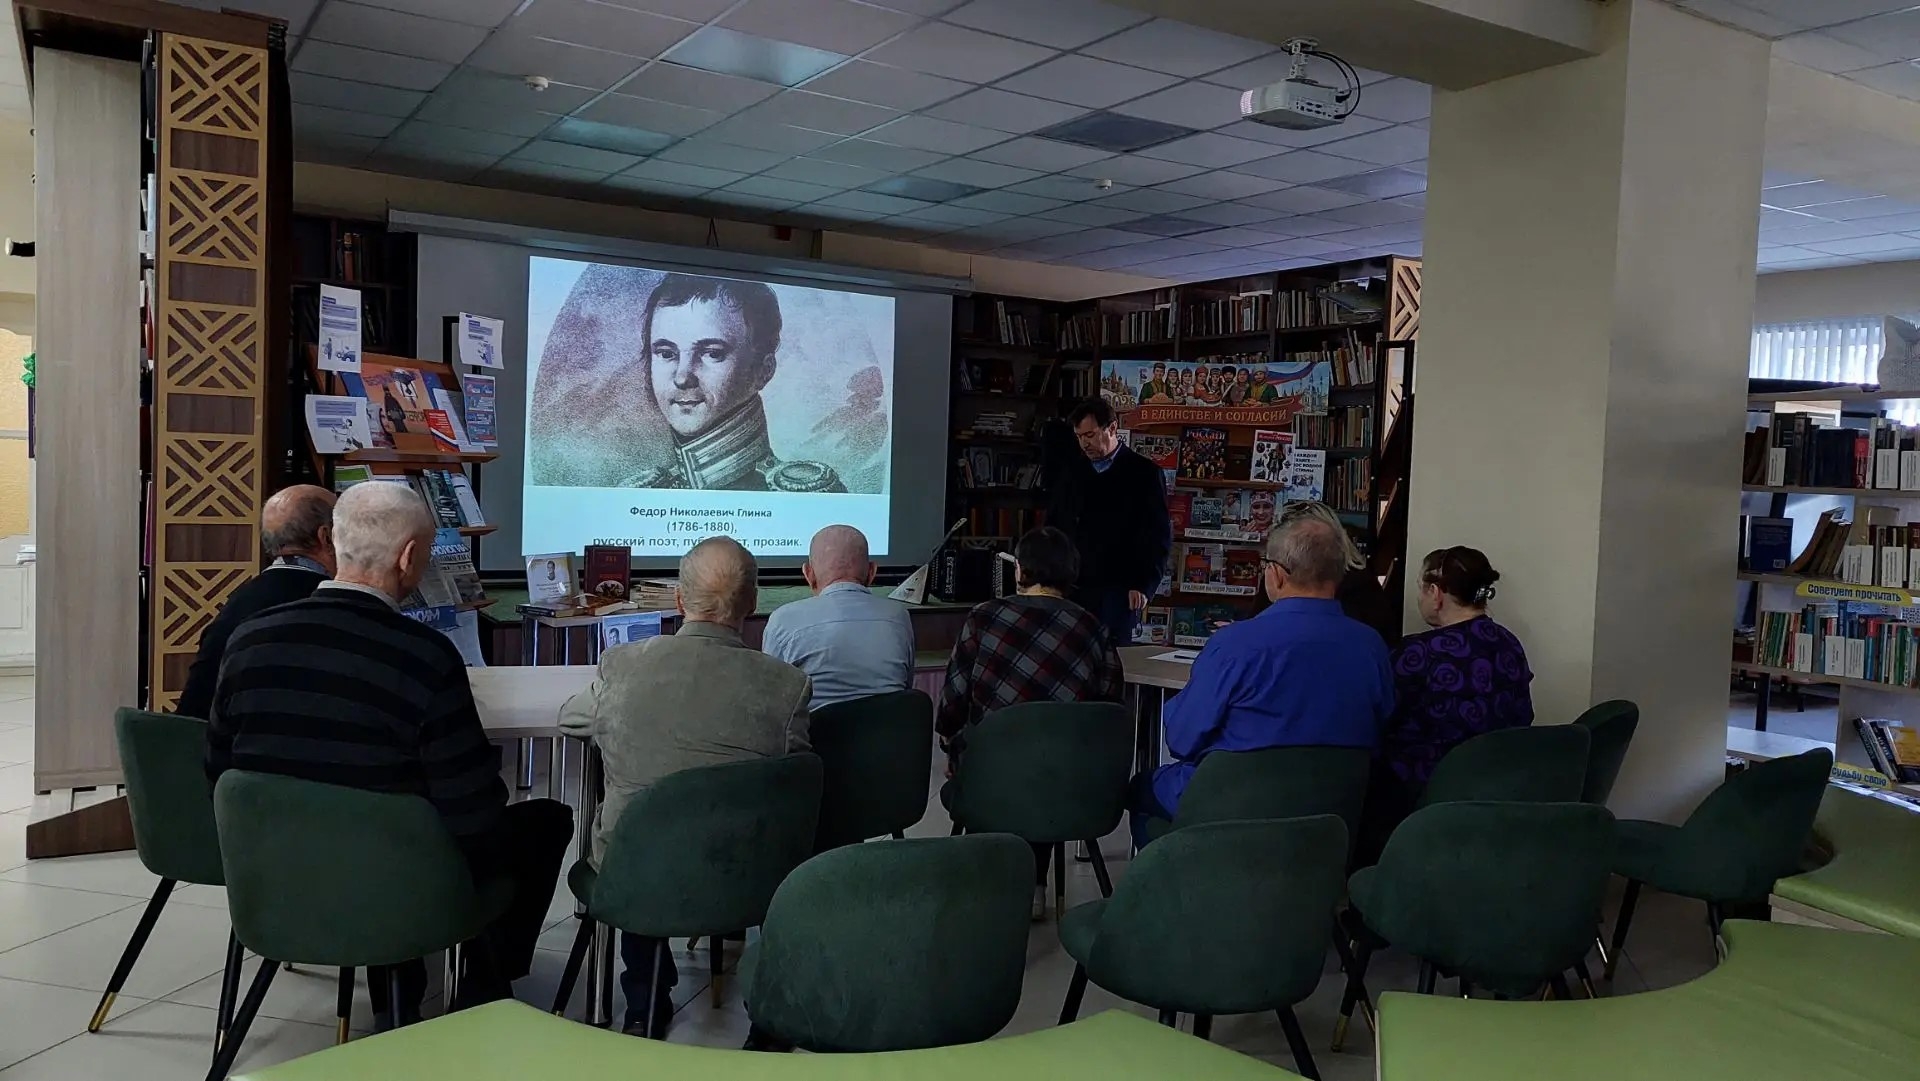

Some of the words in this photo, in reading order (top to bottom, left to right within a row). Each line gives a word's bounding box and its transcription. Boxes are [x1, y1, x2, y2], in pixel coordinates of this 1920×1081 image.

[1141, 409, 1148, 420] В
[1151, 409, 1211, 421] ЕДИНСТВЕ
[1214, 410, 1223, 420] И
[1225, 408, 1288, 421] СОГЛАСИИ
[630, 507, 667, 518] Федор
[670, 507, 735, 517] Николаевич
[737, 508, 772, 518] Глинка
[667, 522, 738, 534] (1786-1880),
[593, 536, 644, 547] русский
[649, 538, 680, 548] поэт,
[753, 538, 803, 548] прозаик.
[1807, 584, 1853, 596] Советуем
[1855, 589, 1902, 602] прочитать
